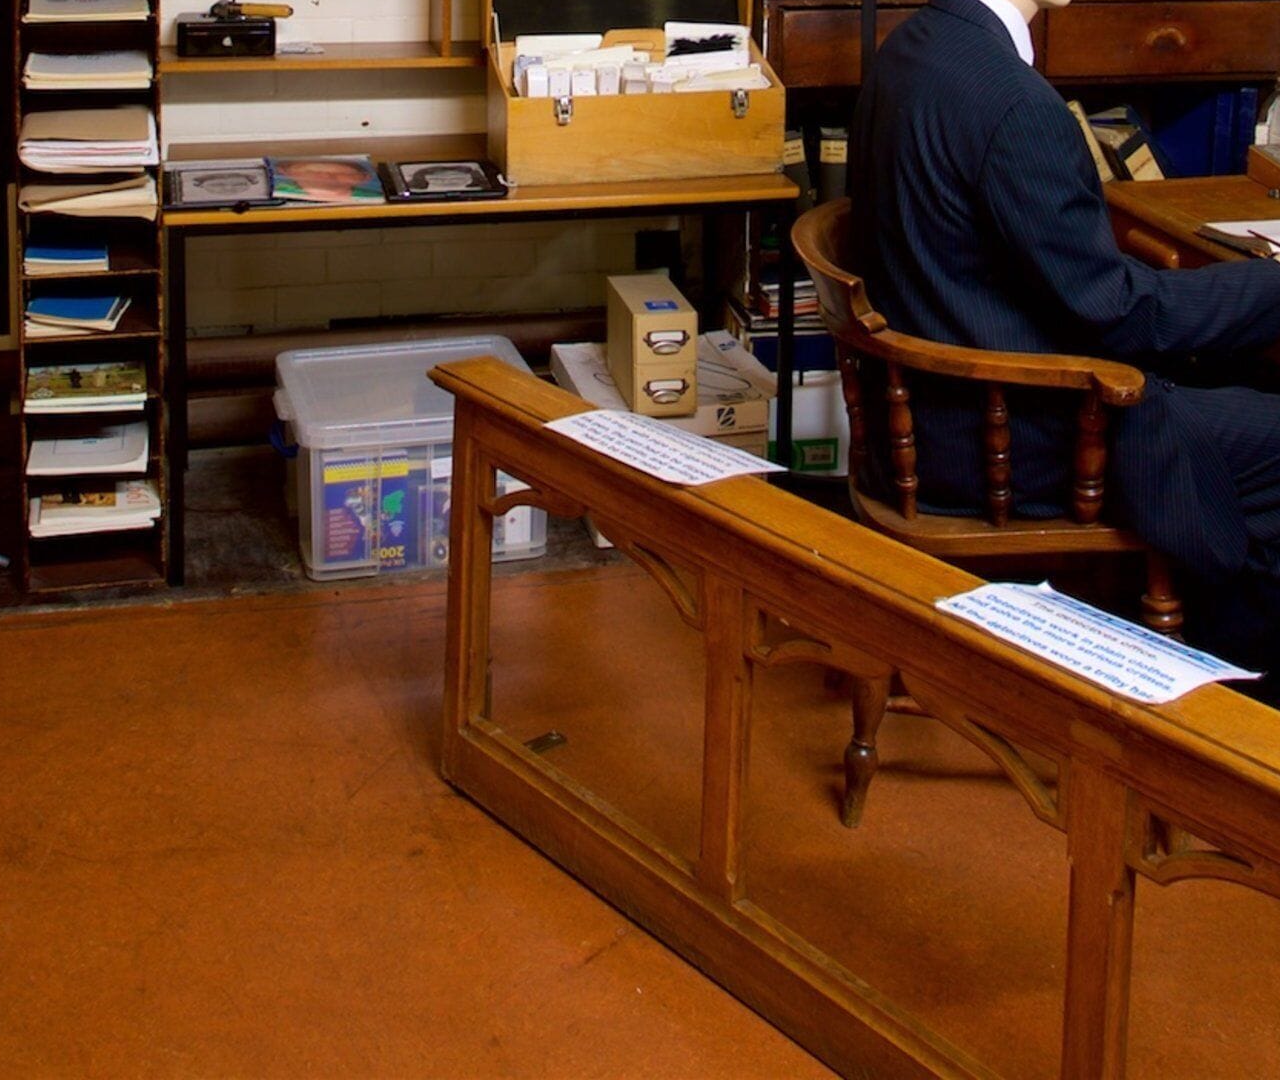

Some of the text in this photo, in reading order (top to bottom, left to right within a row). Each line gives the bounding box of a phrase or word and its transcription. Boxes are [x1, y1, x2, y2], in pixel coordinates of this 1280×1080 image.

[986, 593, 1048, 624] Detectives
[1049, 622, 1079, 639] work
[1092, 643, 1127, 661] plain
[1128, 657, 1176, 683] clothes
[986, 620, 1049, 650] detectives
[1093, 668, 1129, 689] trilby
[1043, 630, 1077, 647] more
[1076, 645, 1124, 669] serious
